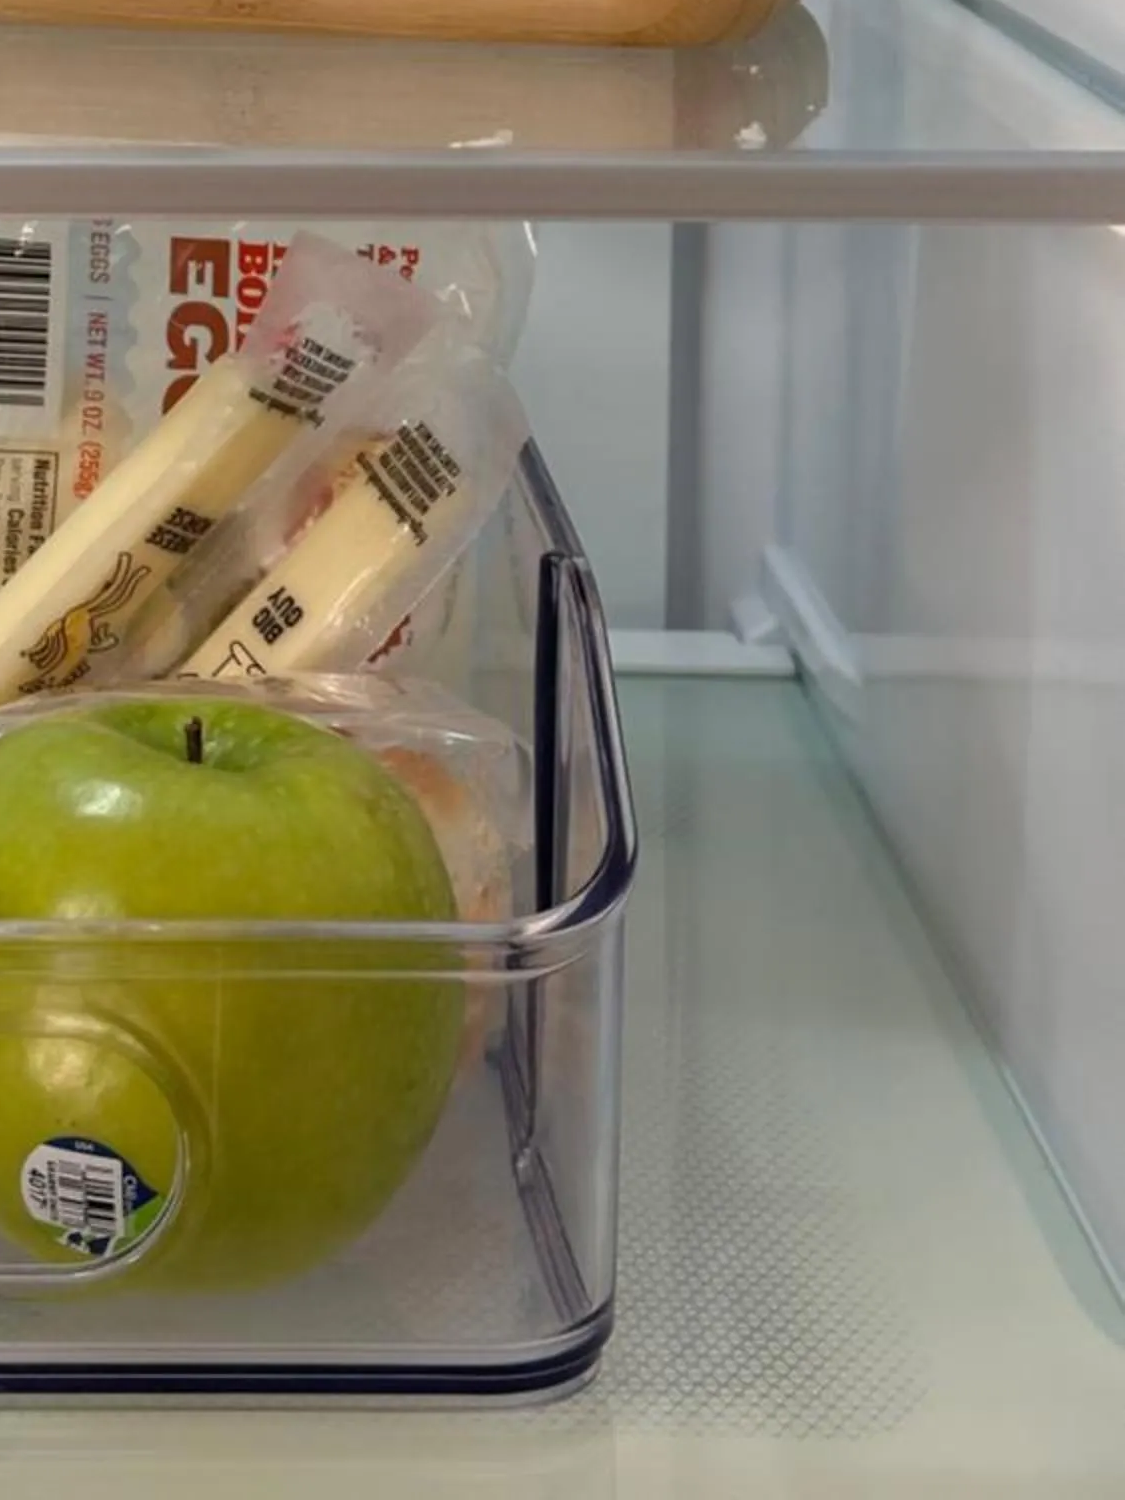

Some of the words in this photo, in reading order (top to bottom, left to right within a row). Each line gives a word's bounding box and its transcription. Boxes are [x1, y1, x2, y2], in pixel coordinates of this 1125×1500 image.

[89, 231, 111, 284] EGGS
[86, 311, 108, 348] NET
[83, 389, 105, 402] 9
[28, 459, 51, 531] Nutrition
[2, 508, 25, 575] Calories
[252, 606, 284, 645] BIG
[267, 585, 305, 628] GUY
[28, 1167, 49, 1210] 4017
